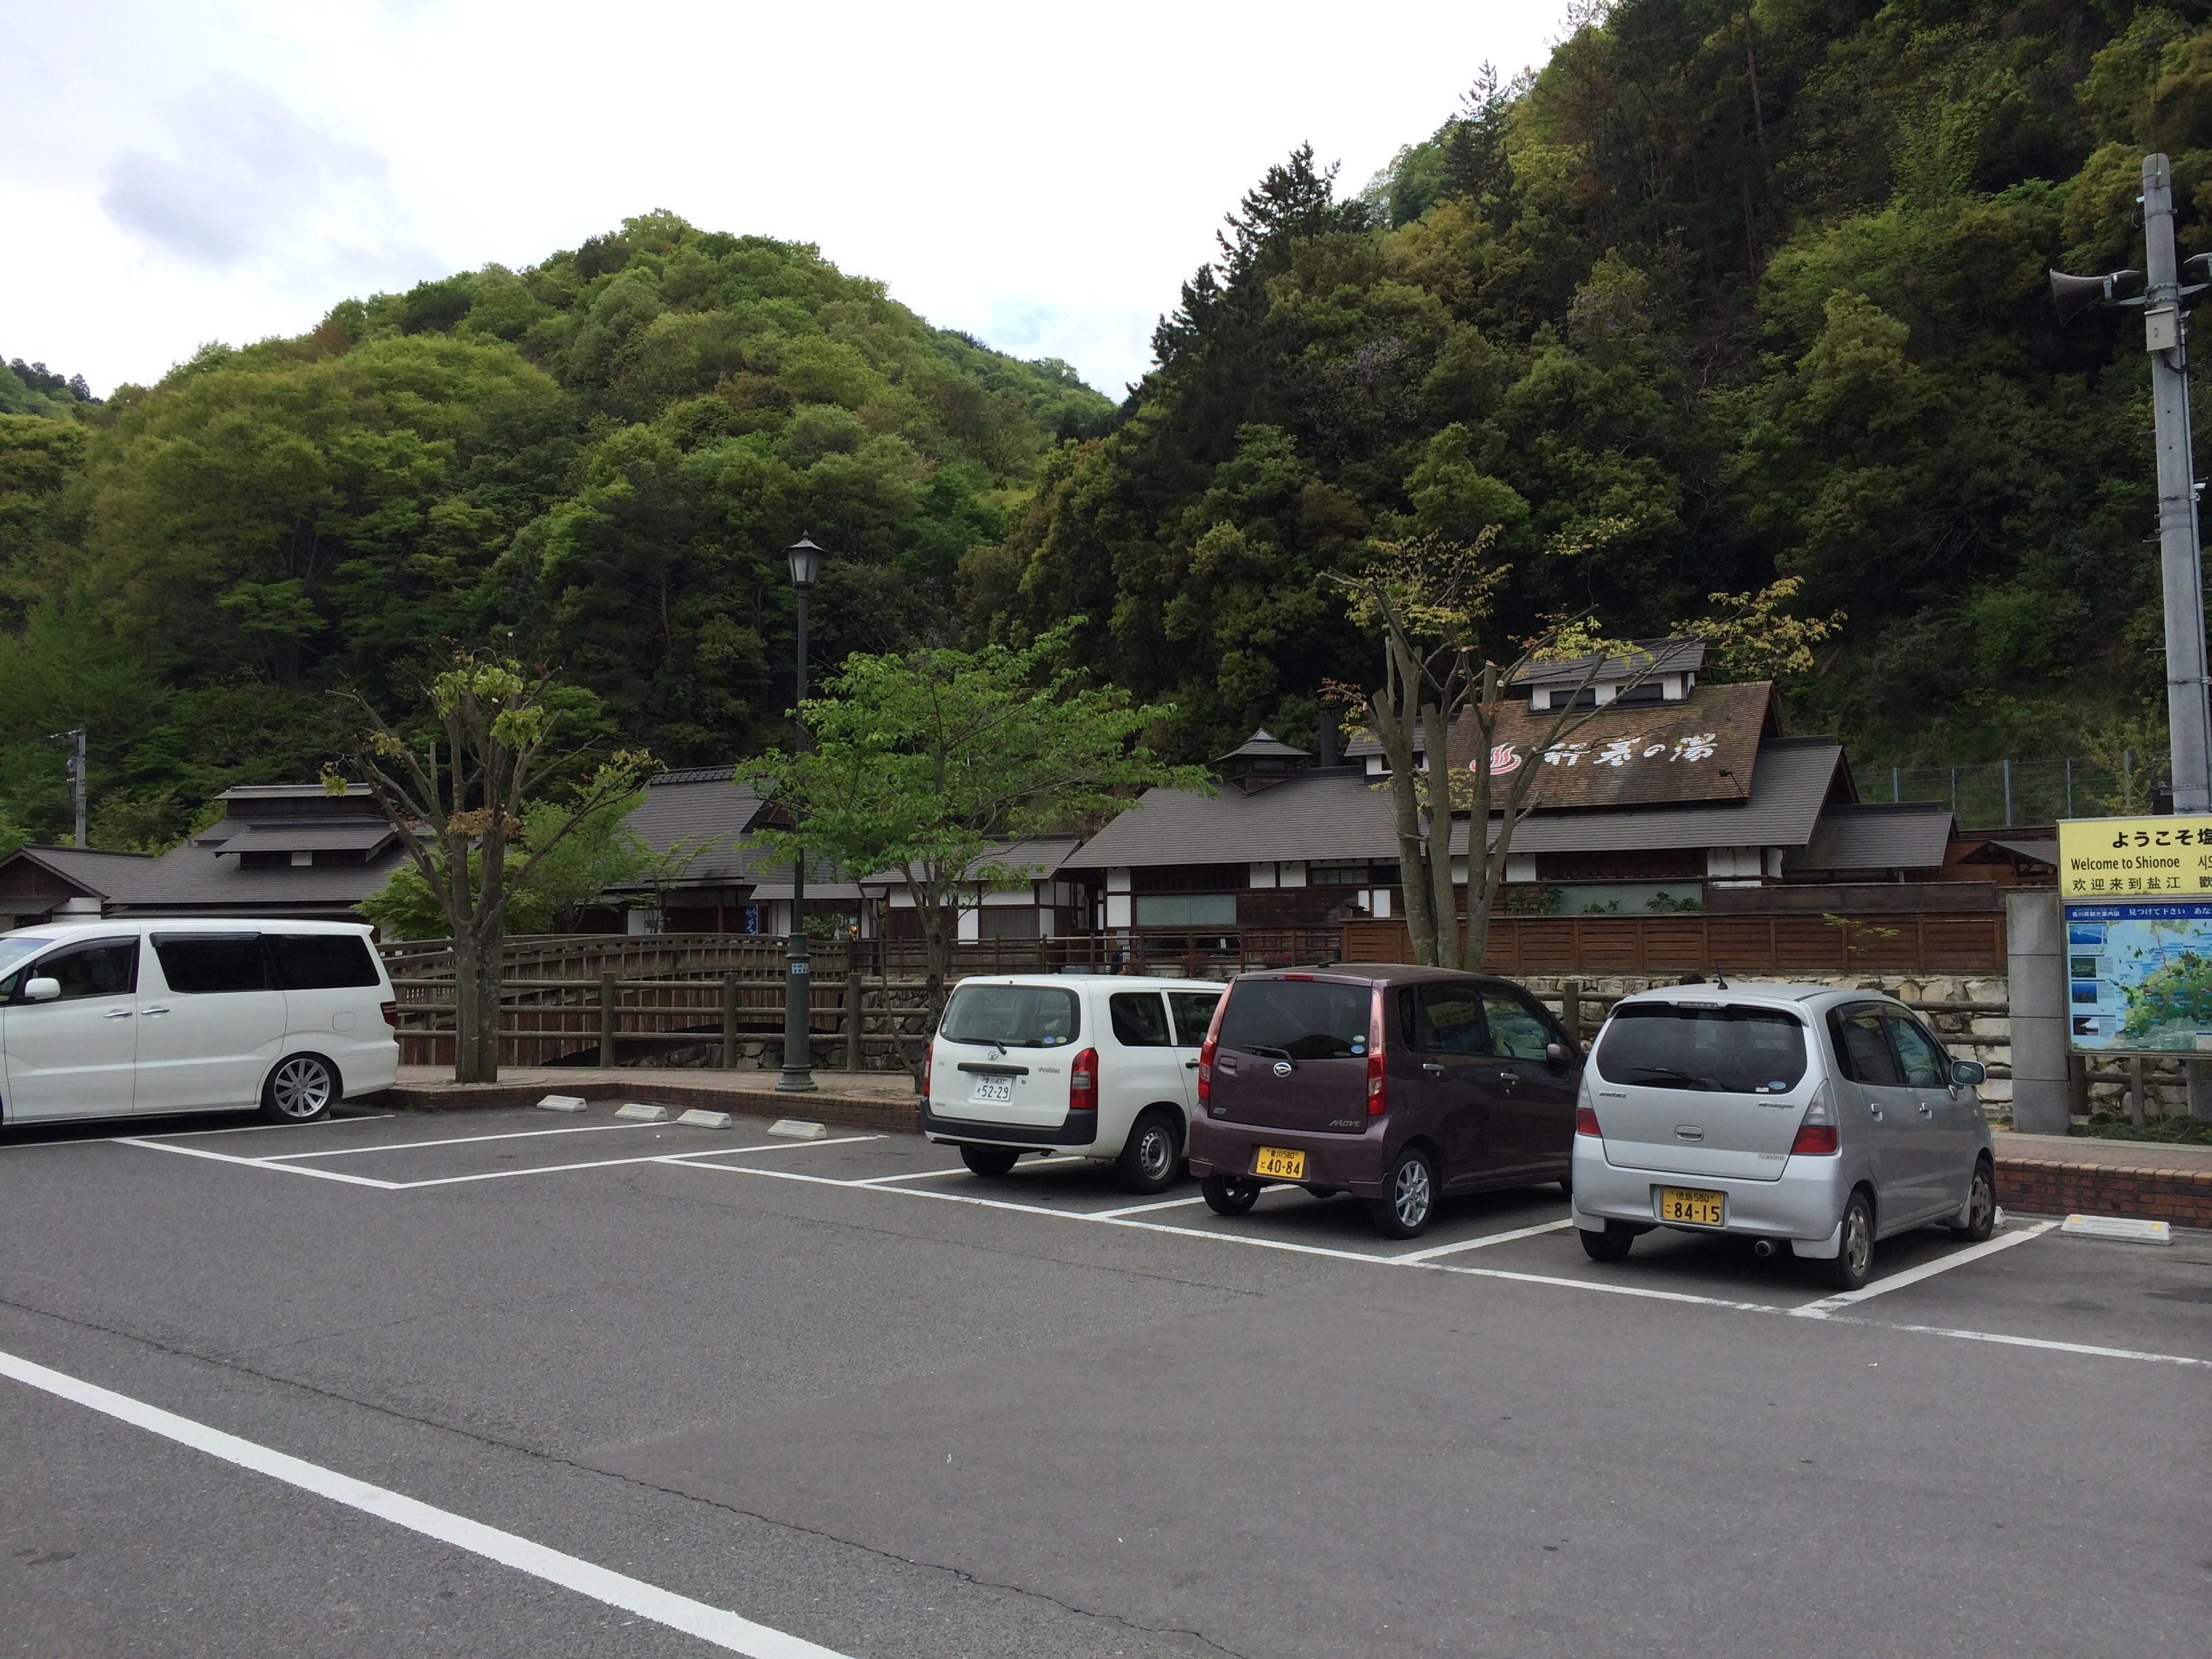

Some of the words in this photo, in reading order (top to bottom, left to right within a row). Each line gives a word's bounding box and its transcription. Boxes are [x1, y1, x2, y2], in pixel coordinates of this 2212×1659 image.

[2112, 828, 2212, 848] ようこそ塩
[2071, 857, 2119, 871] Welcome
[2122, 859, 2133, 869] to
[2135, 856, 2180, 869] Shionoe
[2072, 876, 2181, 891] 欢迎来到盐江
[2129, 907, 2186, 916] 見つけて下さい
[982, 1085, 1009, 1099] 52-29
[1329, 1119, 1361, 1128] MOVE
[1267, 1158, 1300, 1176] 40-84
[1674, 1202, 1720, 1223] 84-15
